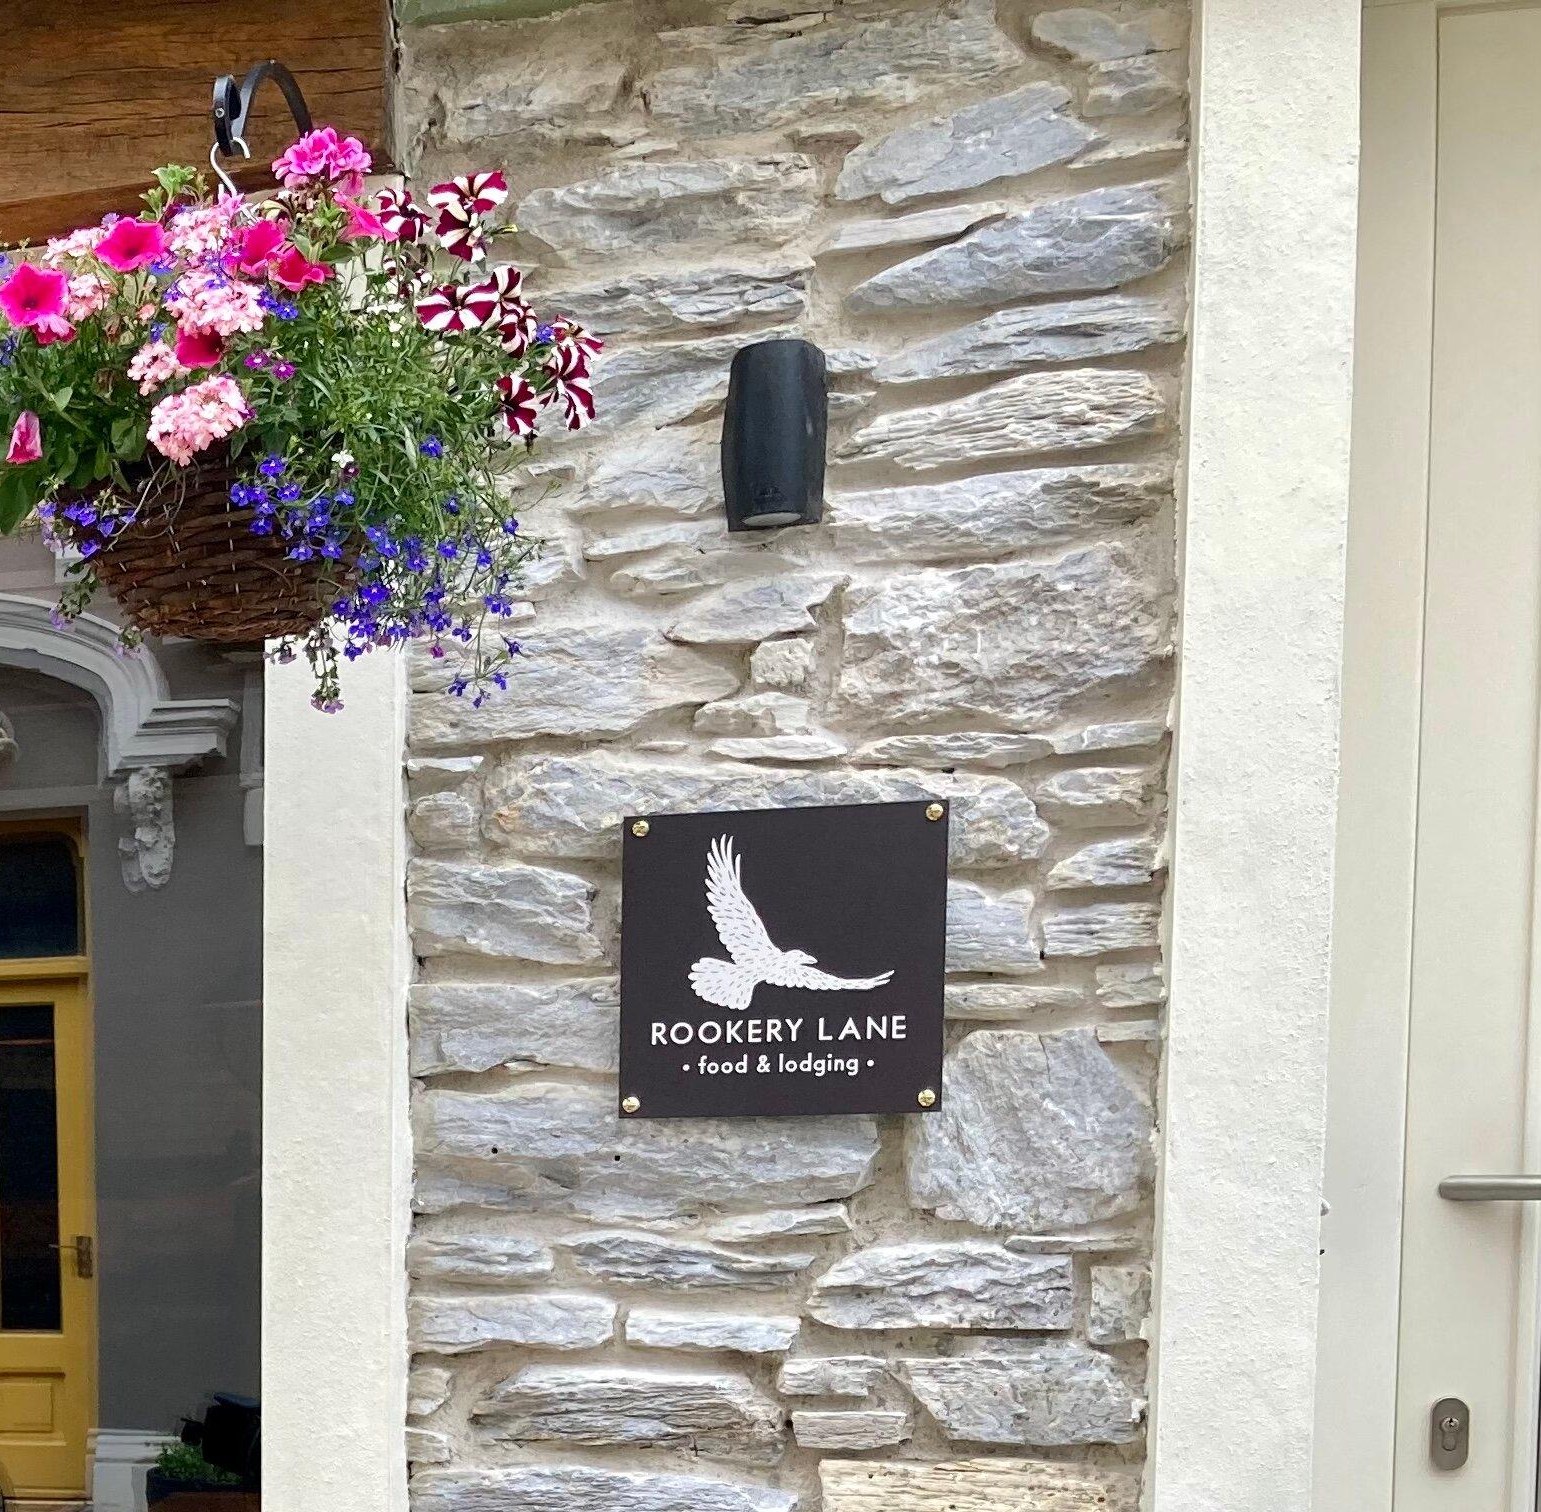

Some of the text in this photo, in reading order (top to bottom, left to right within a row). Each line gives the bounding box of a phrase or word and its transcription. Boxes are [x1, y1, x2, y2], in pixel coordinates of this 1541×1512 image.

[651, 1015, 907, 1045] ROOKERY LANE
[697, 1053, 859, 1077] food & lodging
